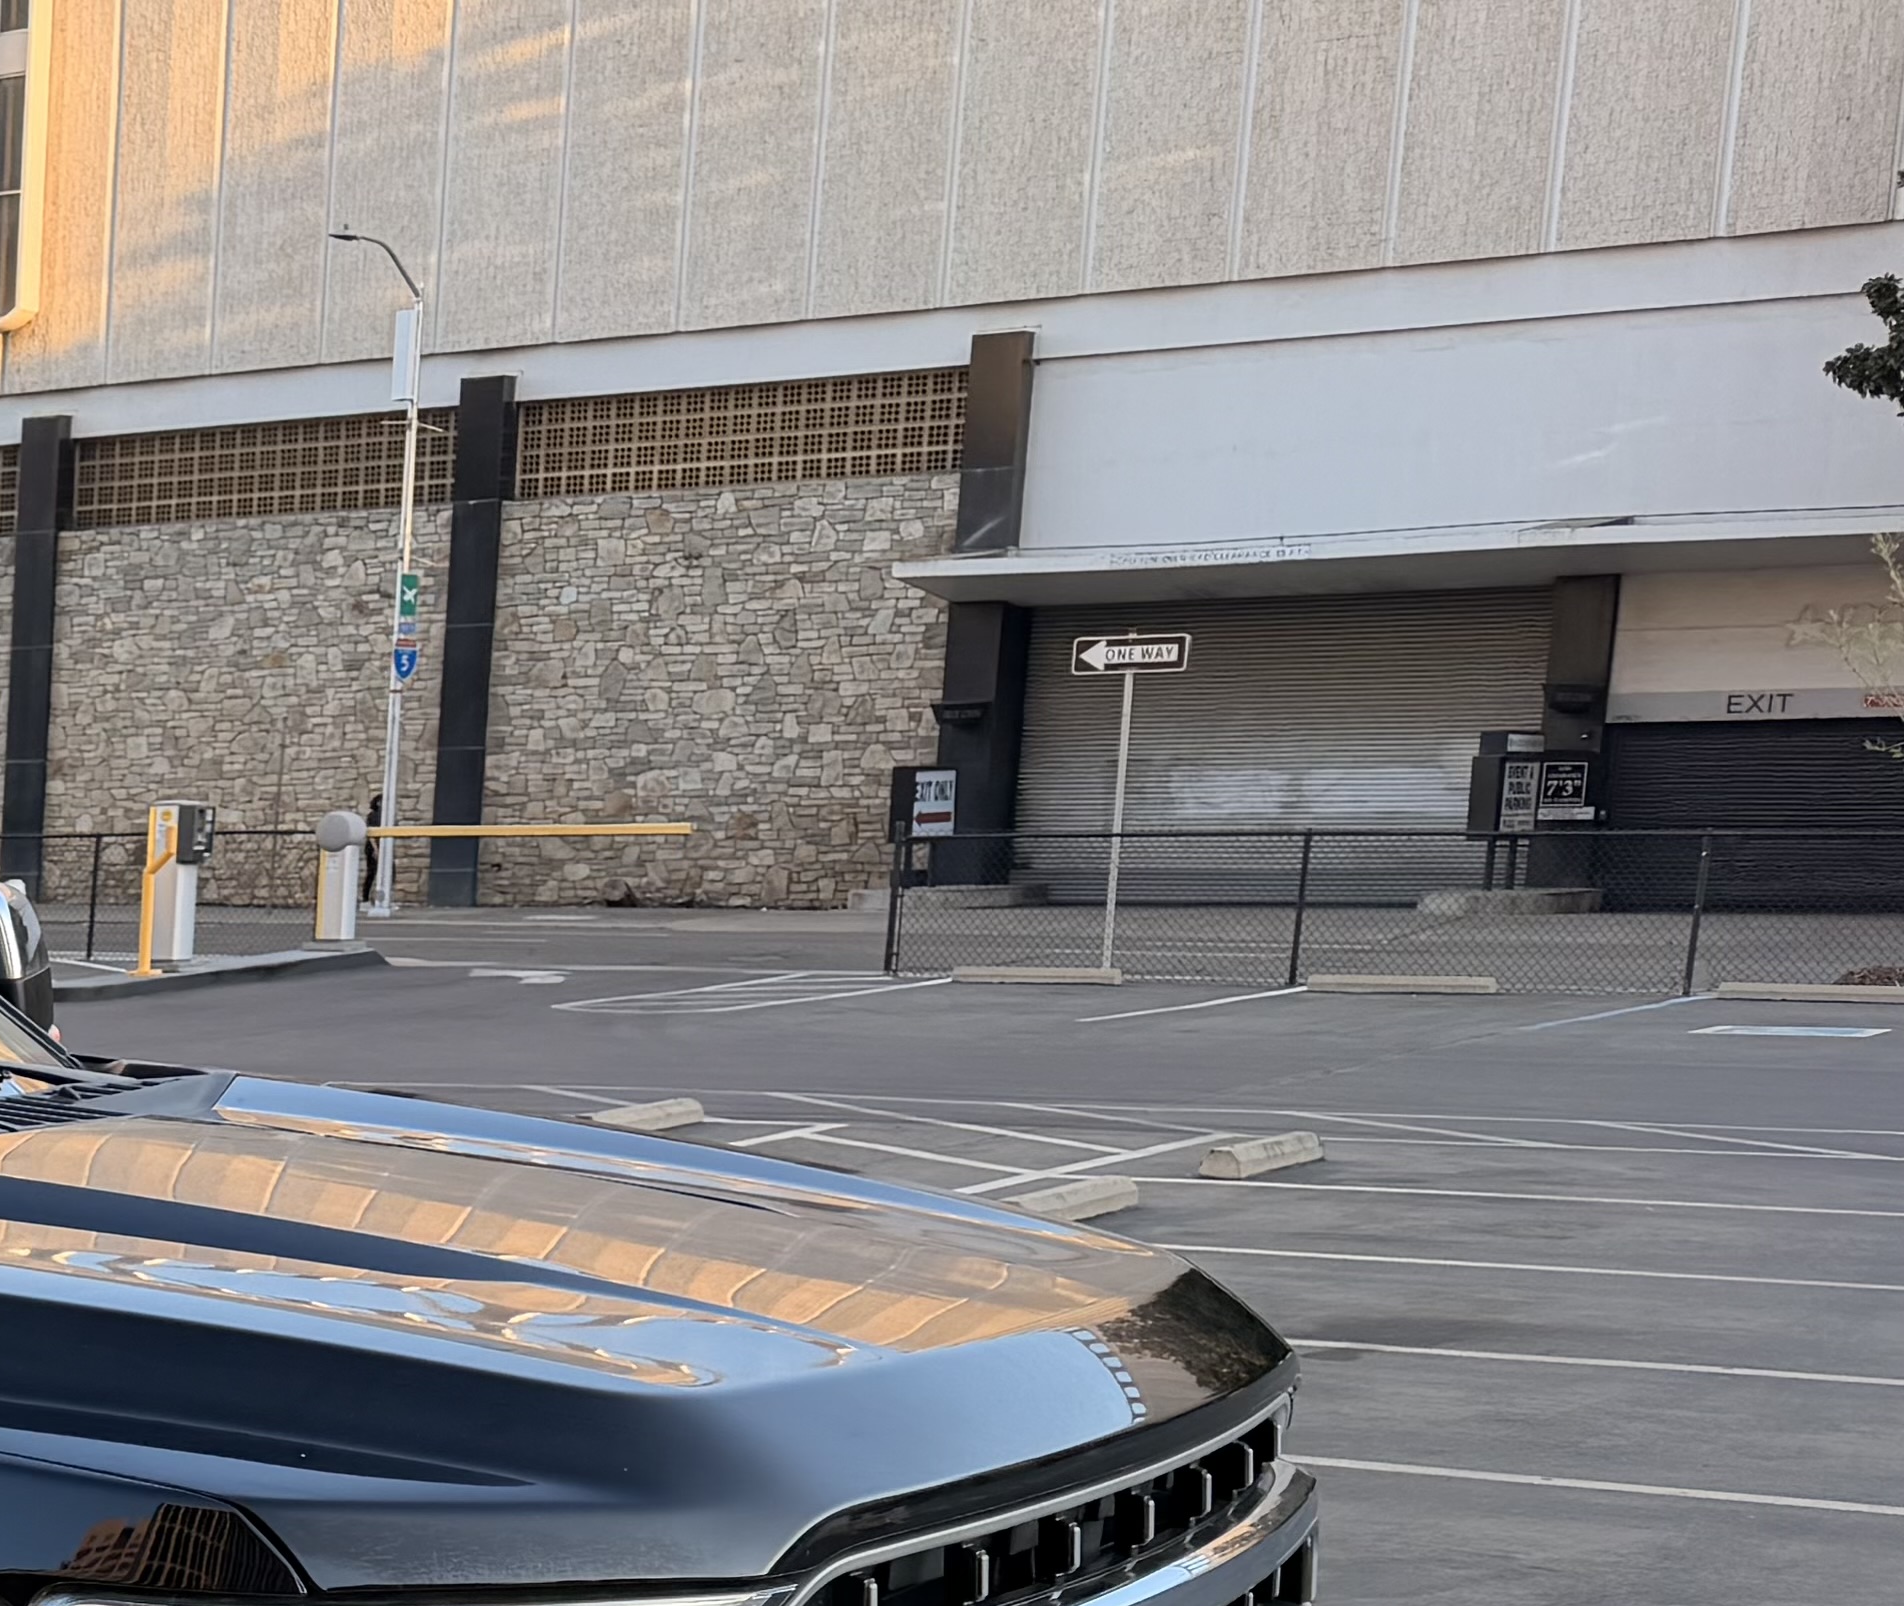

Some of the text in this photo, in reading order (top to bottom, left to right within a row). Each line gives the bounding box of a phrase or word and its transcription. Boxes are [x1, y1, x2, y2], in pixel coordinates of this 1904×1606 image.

[1106, 645, 1174, 662] ONE WAY
[400, 655, 410, 672] 5
[1726, 693, 1795, 714] EXIT
[1546, 780, 1582, 796] 7'3"
